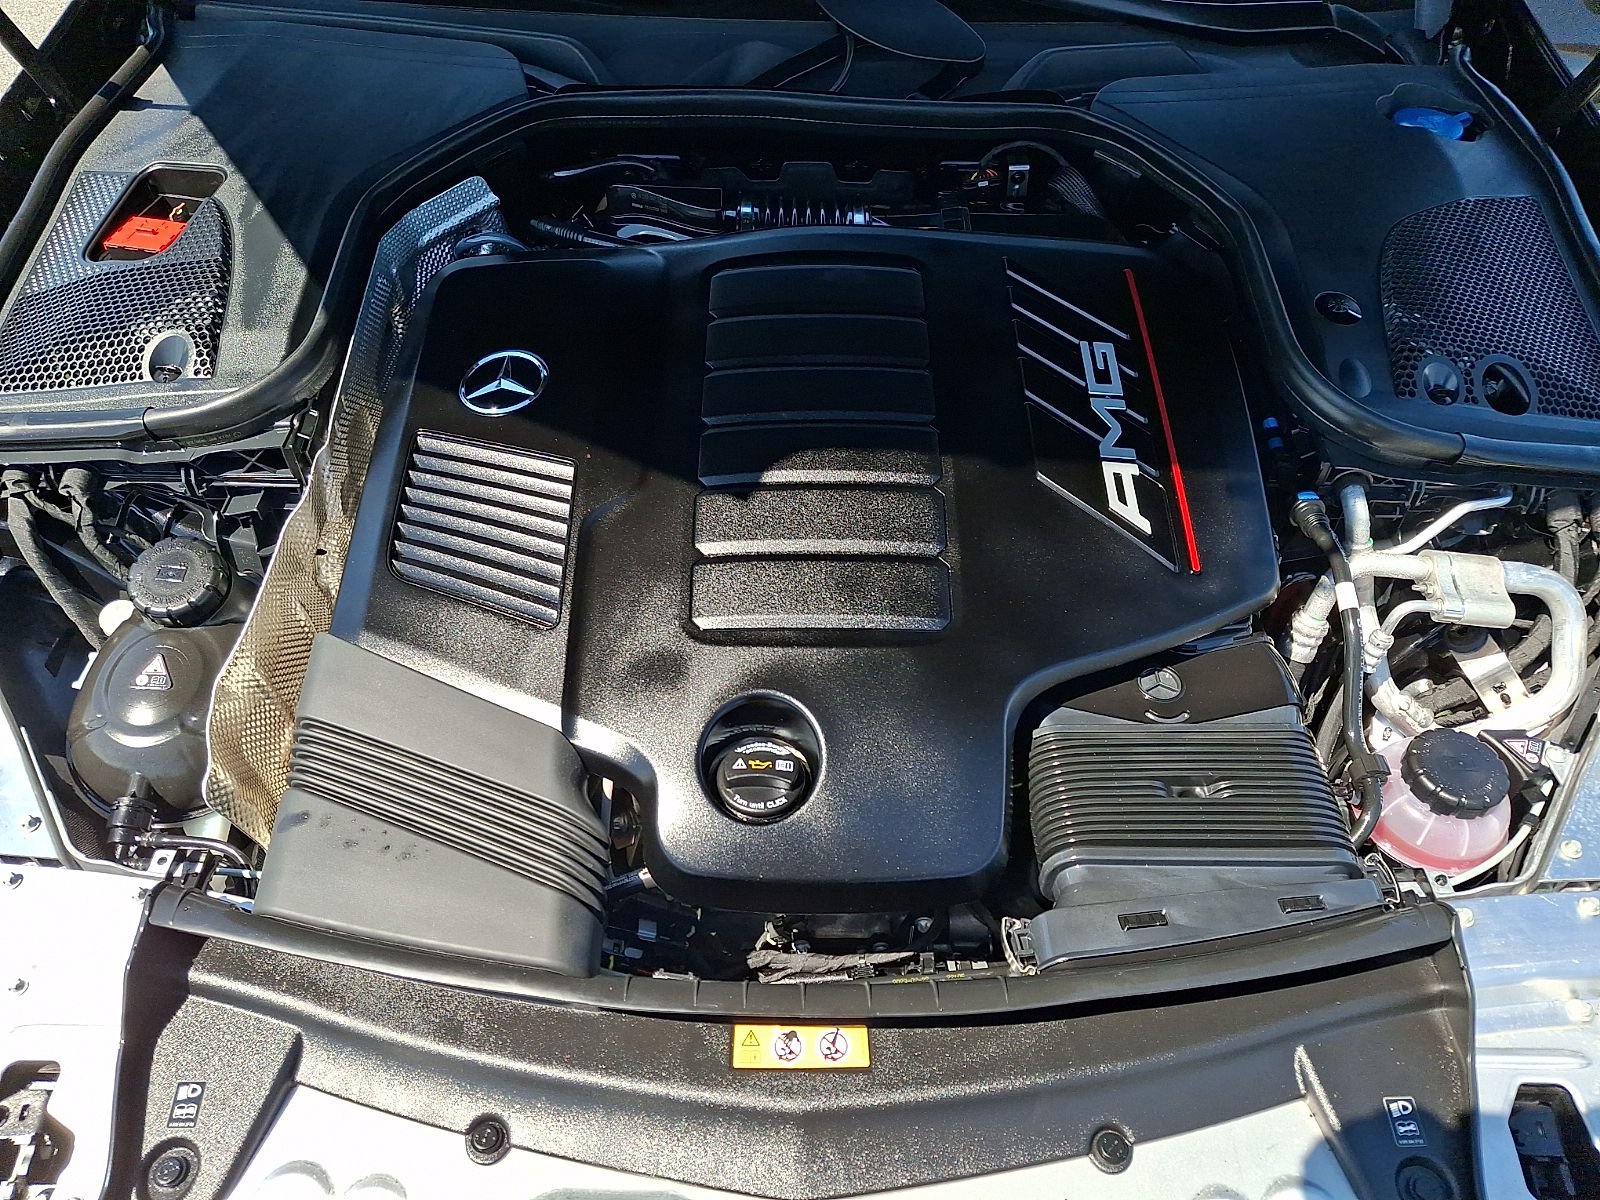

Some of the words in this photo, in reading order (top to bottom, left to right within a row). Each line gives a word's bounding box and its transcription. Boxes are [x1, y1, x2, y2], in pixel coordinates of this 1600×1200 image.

[1080, 341, 1152, 534] AMG
[733, 794, 748, 806] Turn
[766, 796, 788, 809] CLICK
